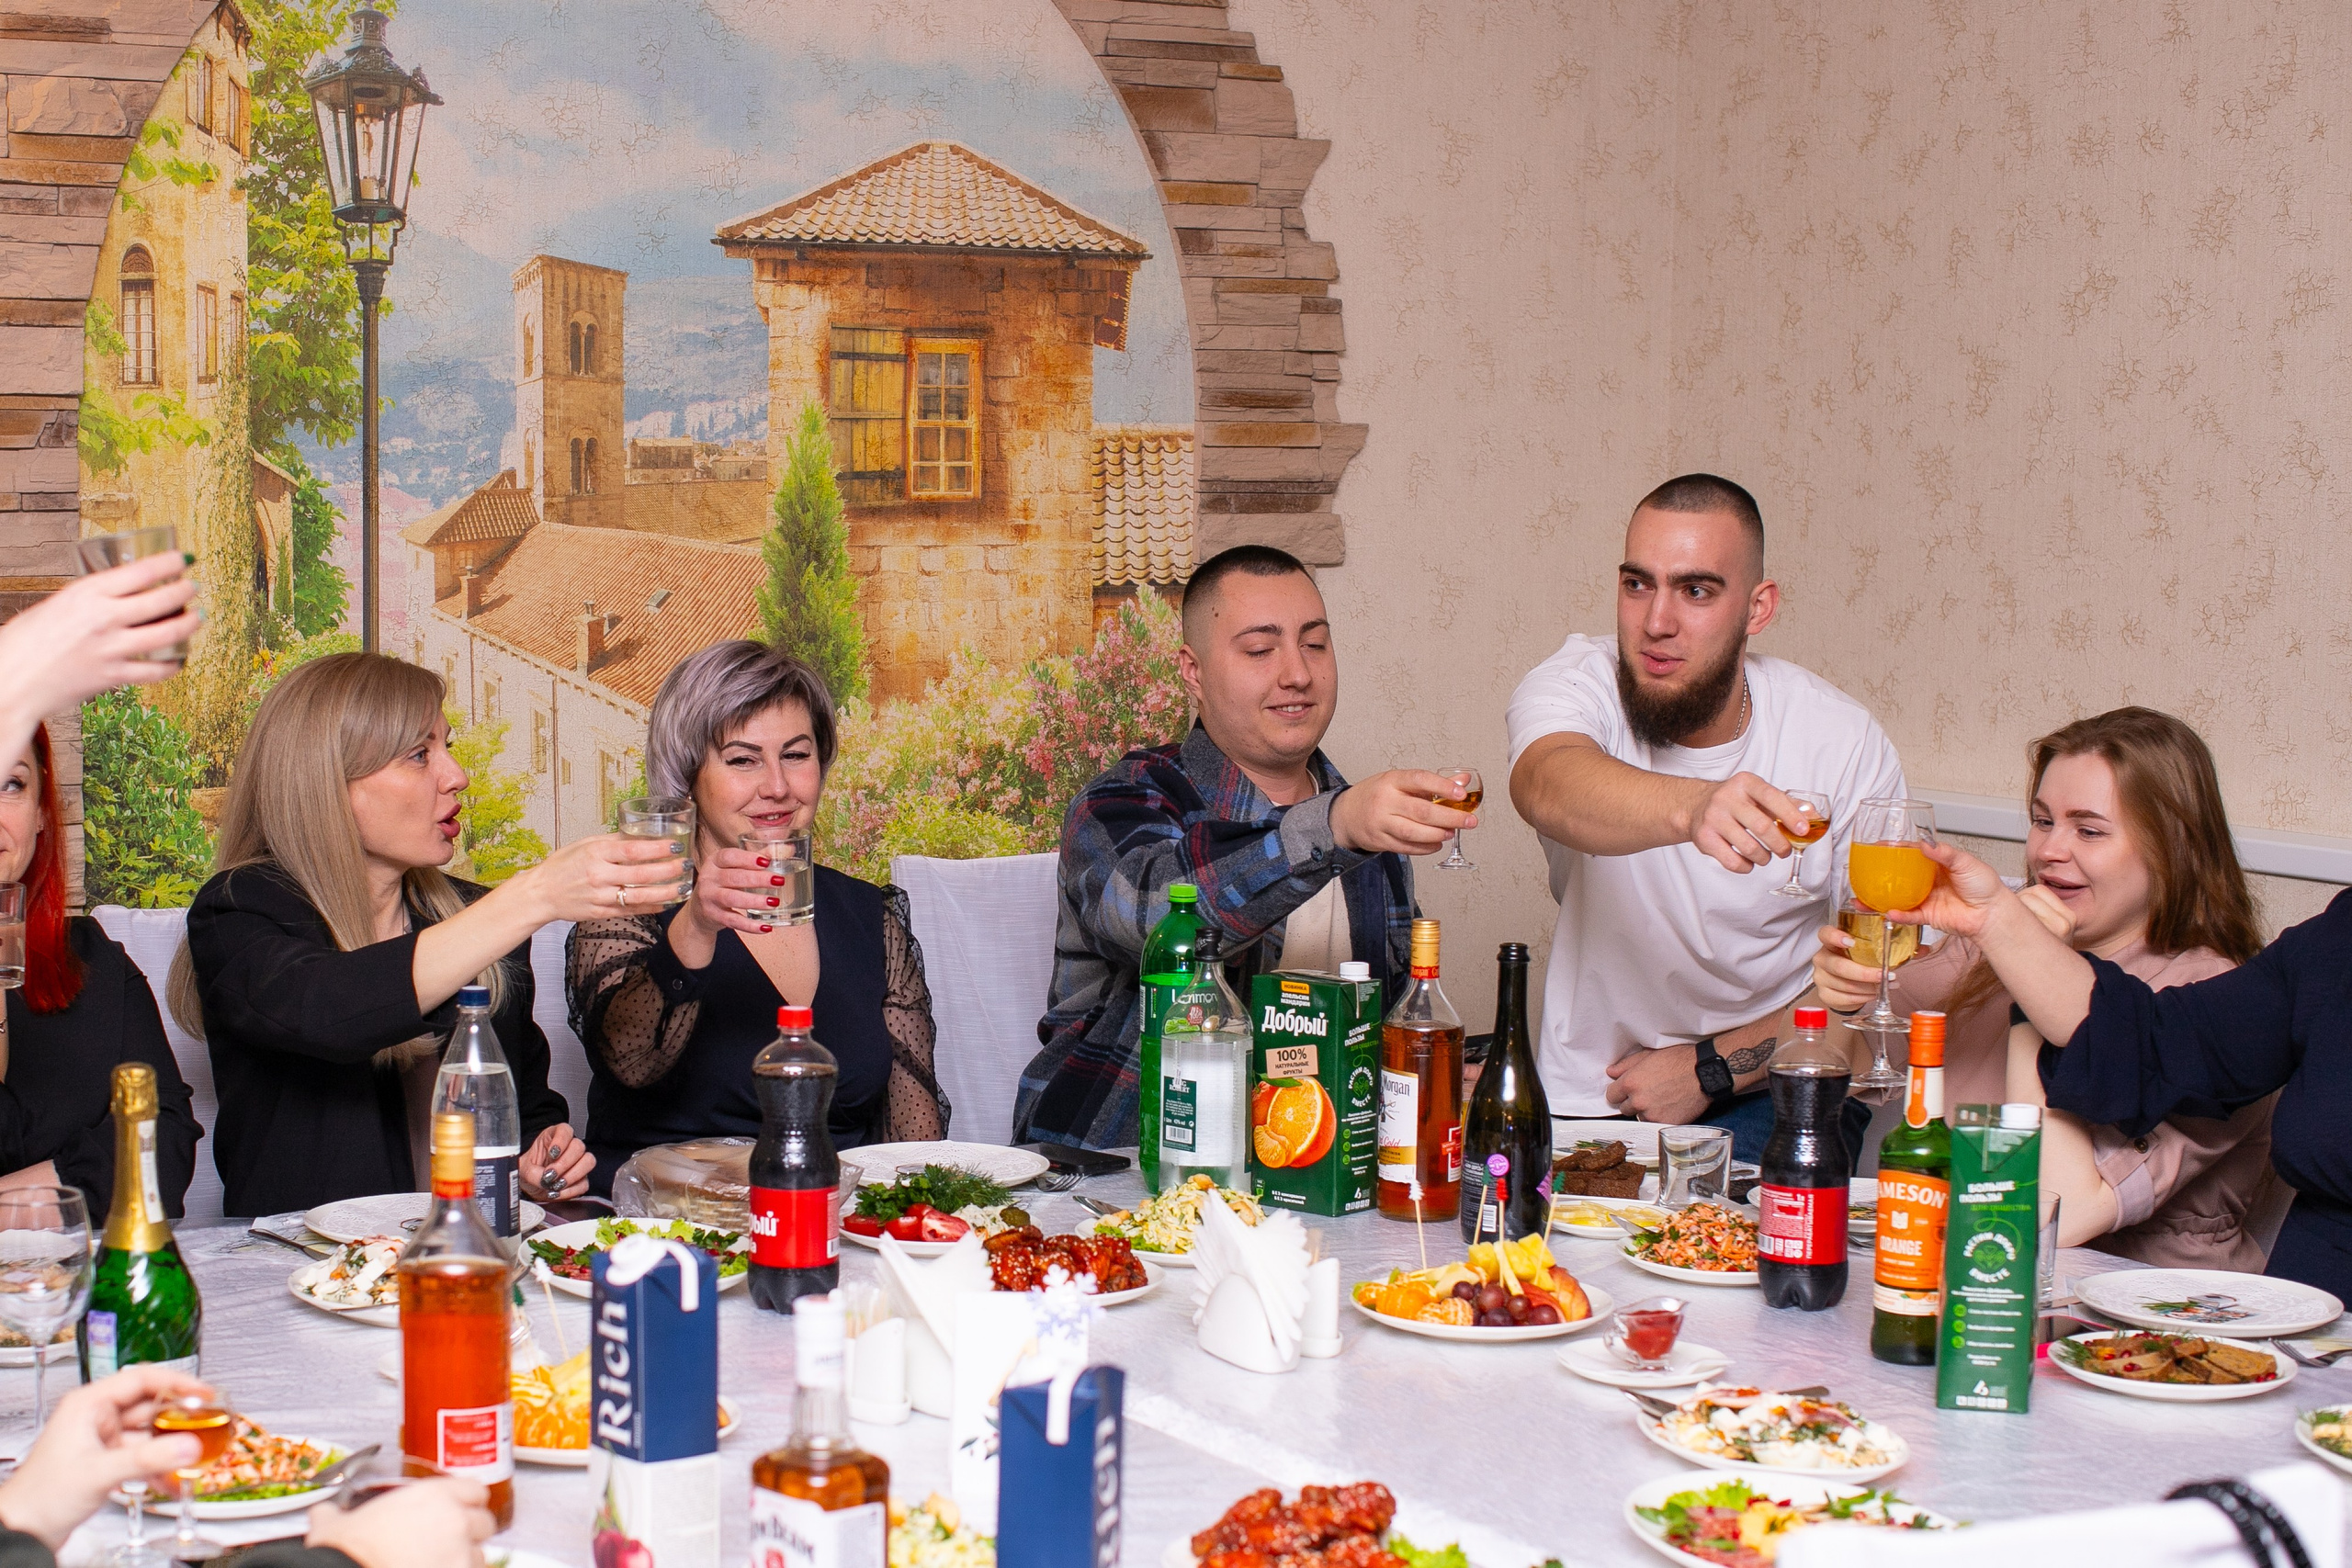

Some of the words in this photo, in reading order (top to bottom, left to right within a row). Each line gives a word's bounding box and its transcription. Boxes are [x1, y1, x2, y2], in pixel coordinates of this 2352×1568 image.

[1280, 998, 1311, 1007] мандарин
[1282, 992, 1309, 1001] апельсин
[1261, 1006, 1327, 1036] Добрый
[1349, 1022, 1371, 1037] БОЛЬШЕ
[1344, 1033, 1365, 1047] ПОЛЬЗЫ
[1277, 1047, 1306, 1062] 100%
[1275, 1061, 1309, 1069] НАТУРАЛЬНЫЕ
[1348, 1066, 1363, 1089] РАСТИМ
[1363, 1066, 1374, 1087] ДОБРО
[1382, 1074, 1410, 1097] Morgan
[1351, 1093, 1372, 1108] ВМЕСТЕ
[1967, 1180, 2016, 1193] БОЛЬШЕ
[1958, 1192, 2003, 1203] ПОЛЬЗЫ
[1880, 1235, 1923, 1256] ORANGE
[1962, 1232, 1994, 1258] РАСТИМ
[1993, 1233, 2016, 1260] ДОБРО
[1968, 1268, 2011, 1283] ВМЕСТЕ
[596, 1301, 632, 1448] Rich
